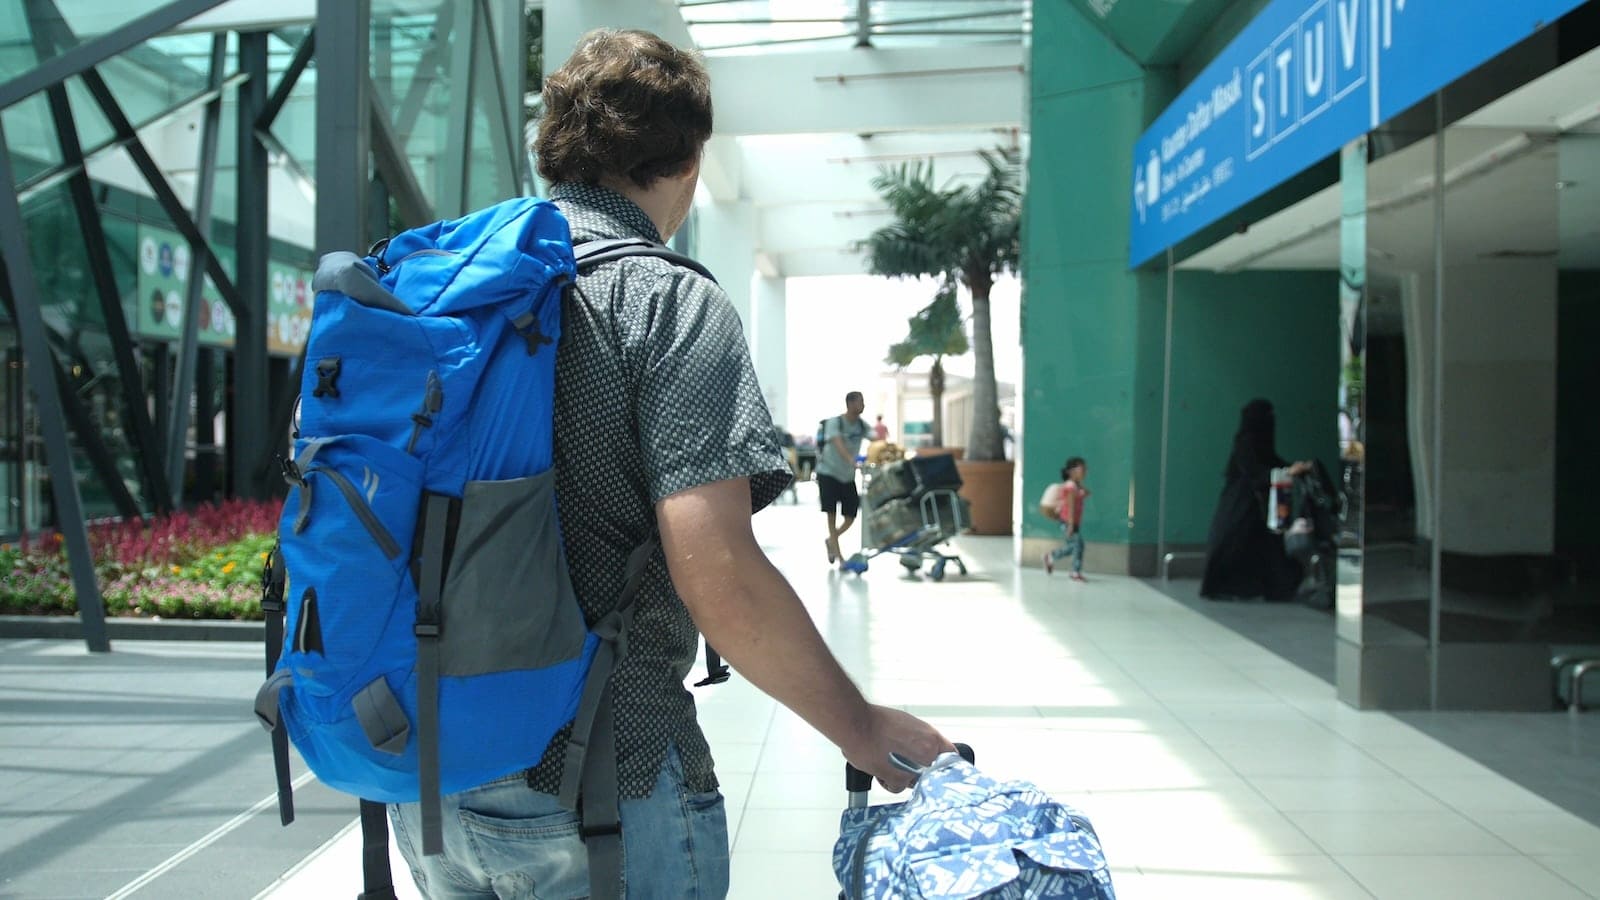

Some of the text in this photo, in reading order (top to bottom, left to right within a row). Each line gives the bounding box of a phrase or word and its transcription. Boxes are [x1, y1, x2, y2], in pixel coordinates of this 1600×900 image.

[1252, 0, 1359, 138] S T U V
